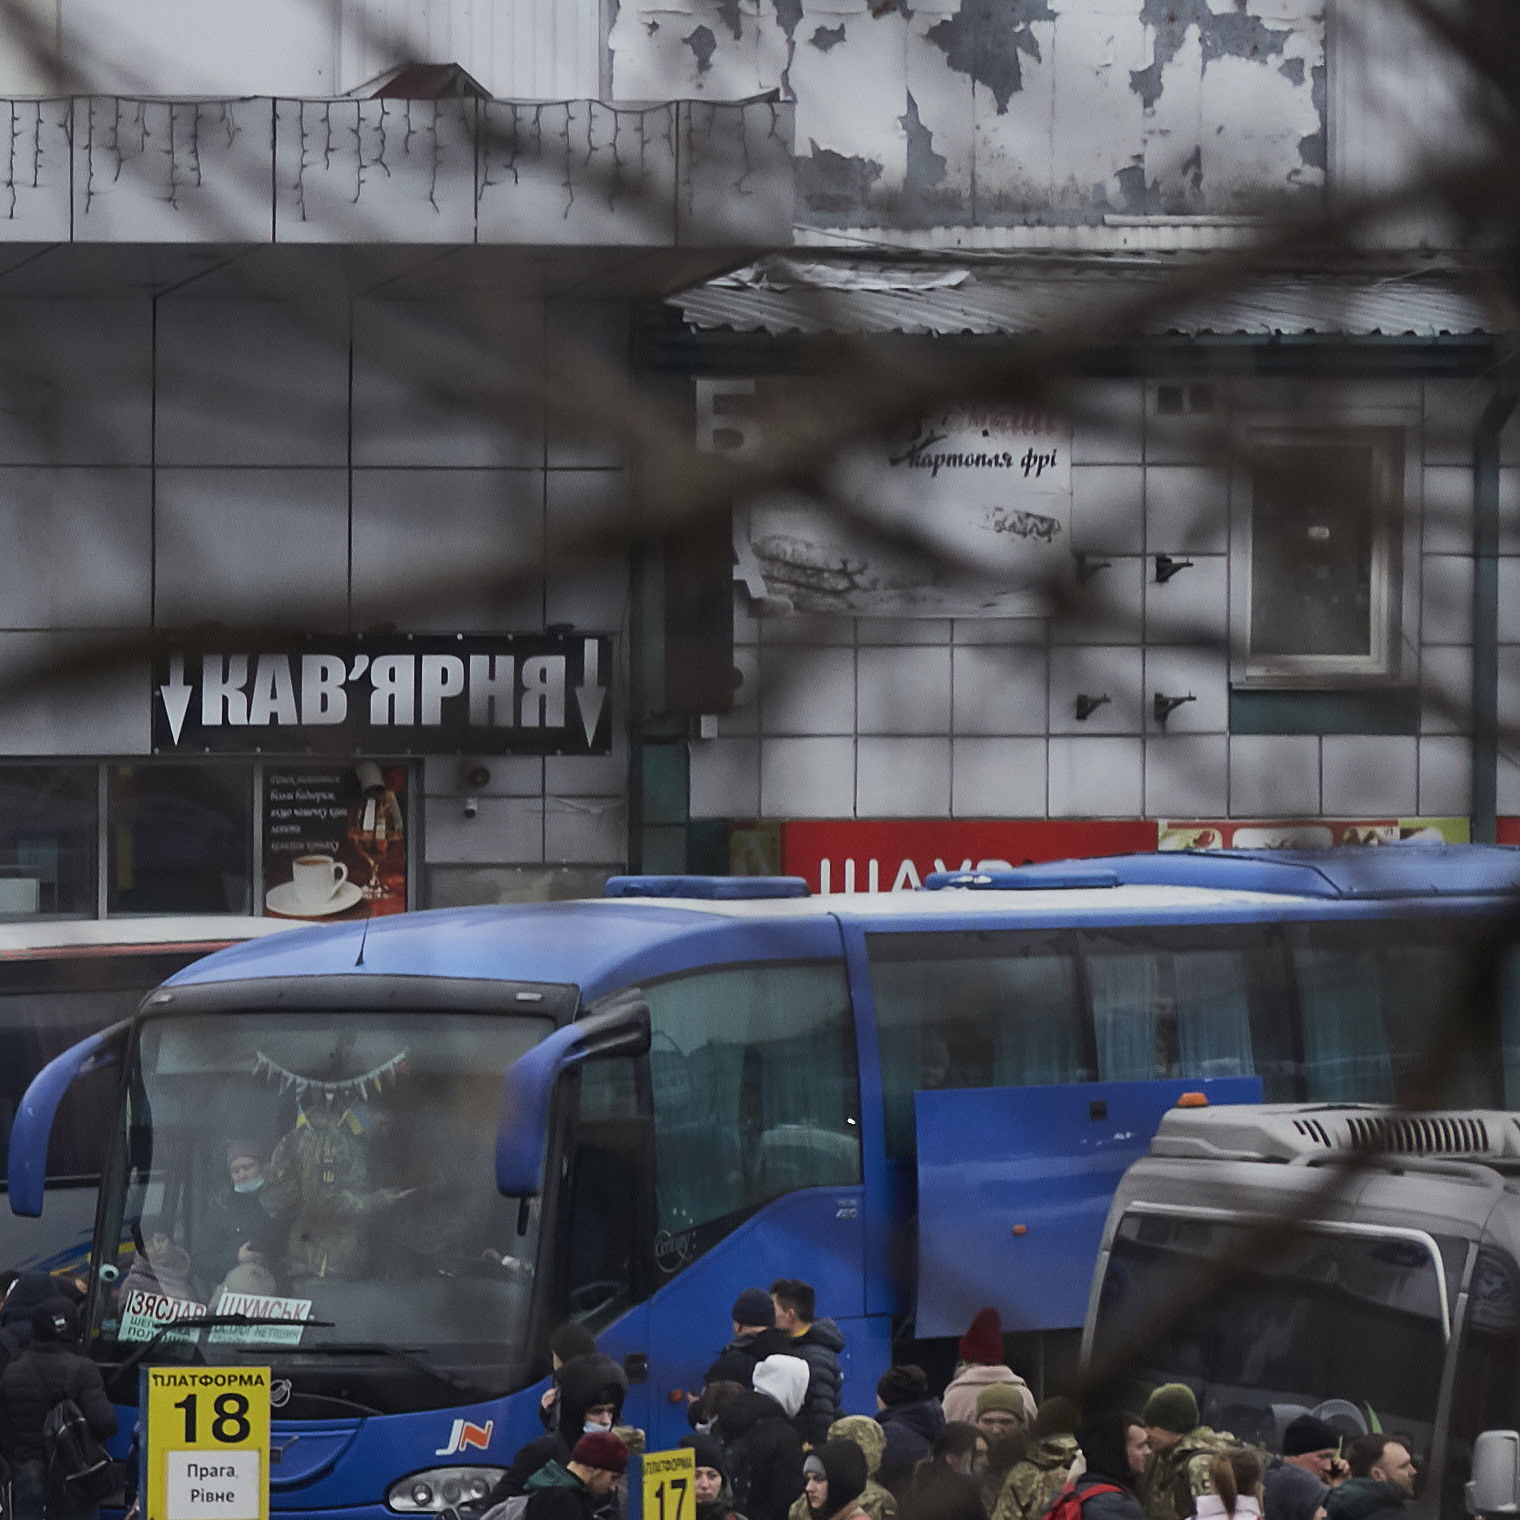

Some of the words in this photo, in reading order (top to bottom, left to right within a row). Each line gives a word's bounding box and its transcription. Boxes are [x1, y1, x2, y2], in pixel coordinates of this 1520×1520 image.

[1020, 447, 1058, 478] фрі
[151, 1373, 265, 1388] ПЛАТФОРМА
[174, 1392, 251, 1443] 18
[190, 1488, 235, 1503] Рівне
